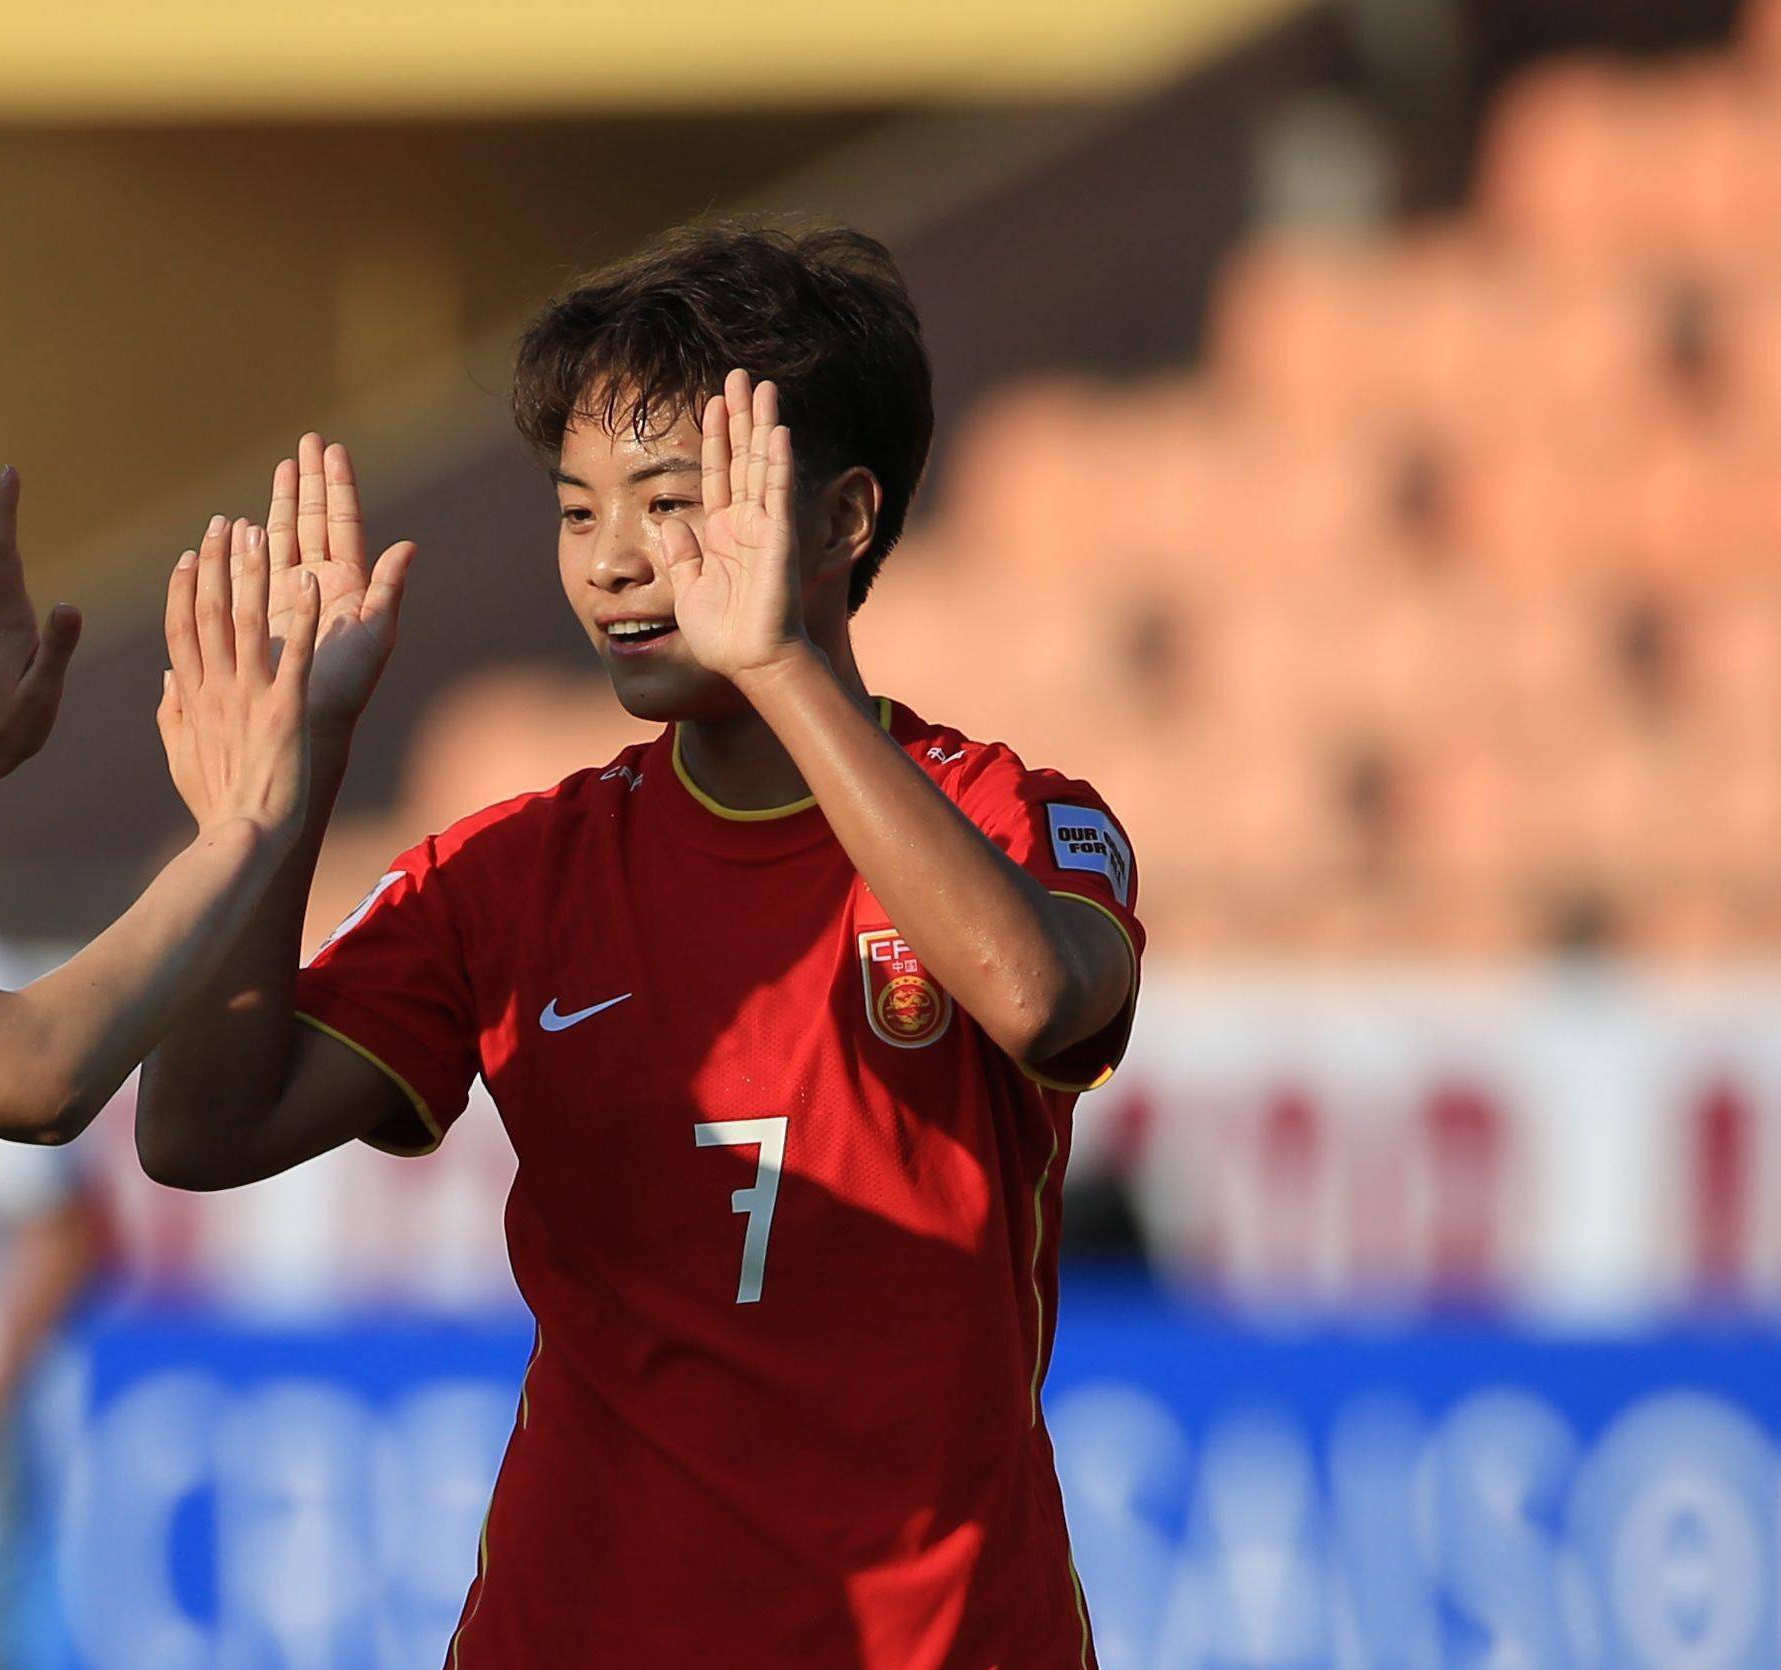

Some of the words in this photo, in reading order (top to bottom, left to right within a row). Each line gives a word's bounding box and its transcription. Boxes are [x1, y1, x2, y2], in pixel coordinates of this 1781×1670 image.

[1057, 827, 1099, 842] OUR
[1068, 843, 1108, 856] FOR
[870, 939, 912, 962] CF
[694, 1116, 789, 1304] 7
